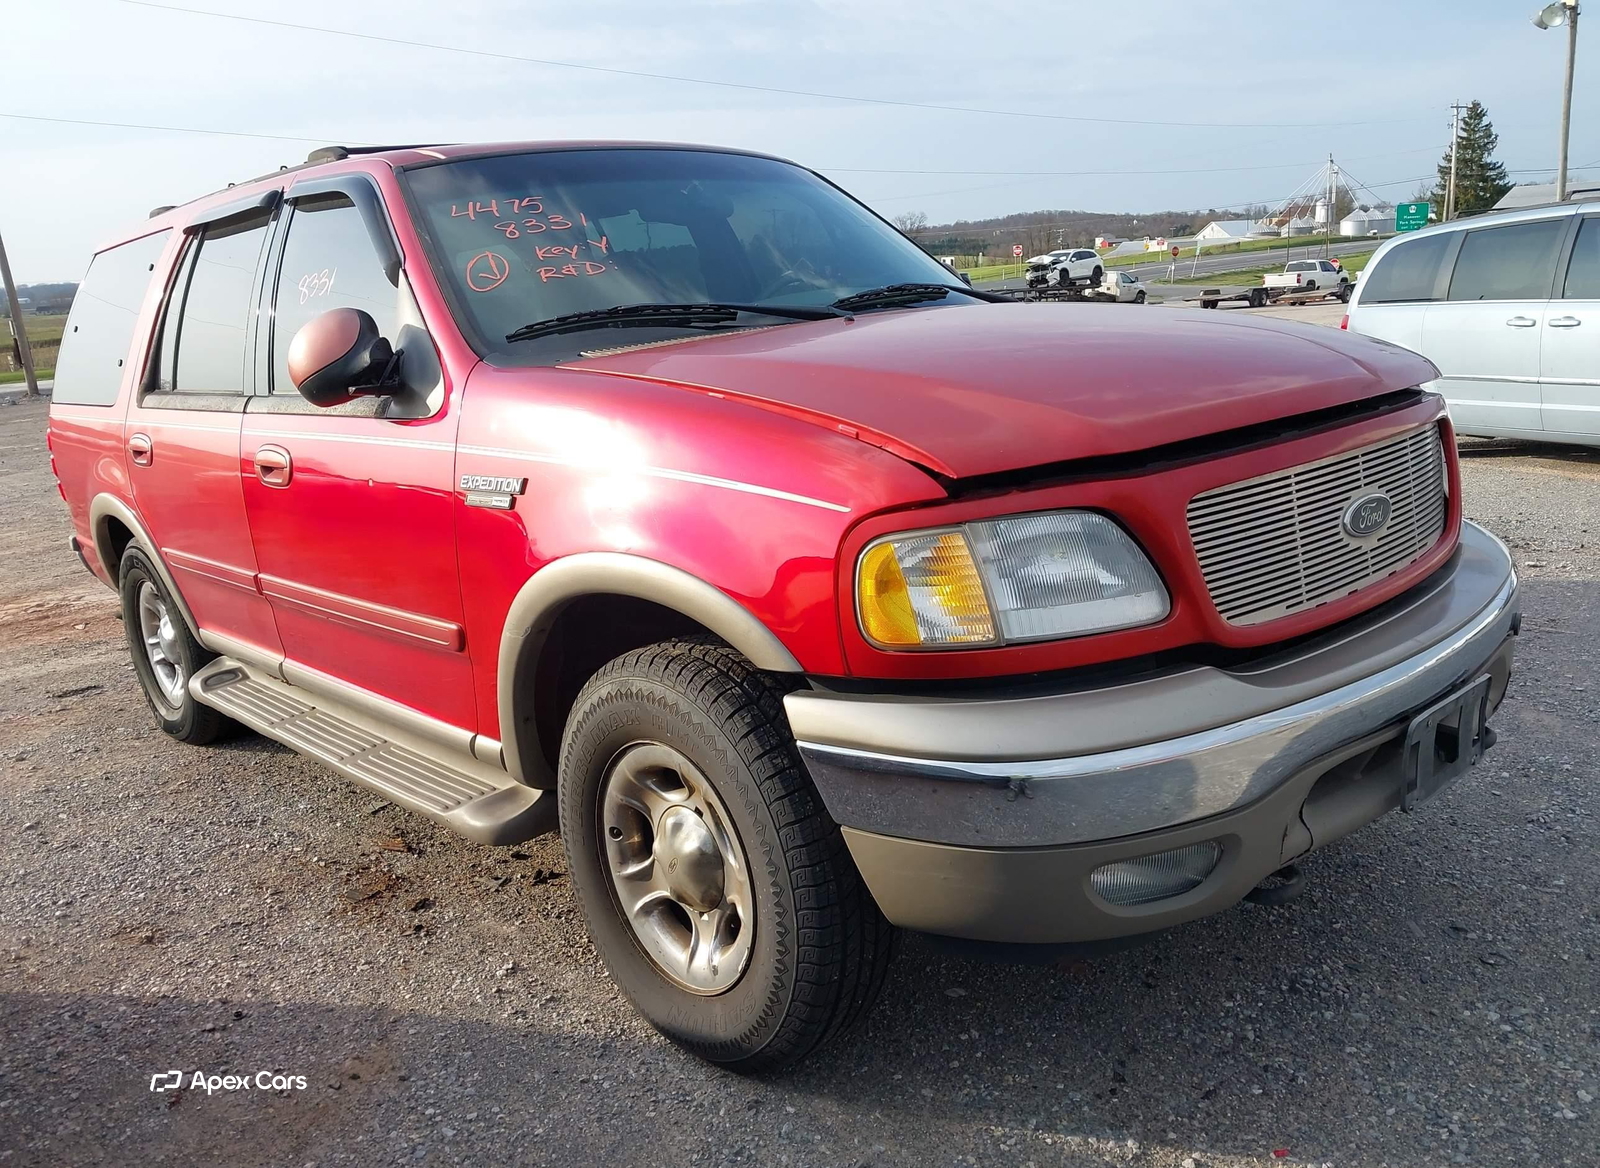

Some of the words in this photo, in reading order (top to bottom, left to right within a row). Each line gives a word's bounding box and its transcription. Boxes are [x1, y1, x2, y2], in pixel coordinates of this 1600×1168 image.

[451, 196, 543, 221] 4475
[494, 212, 587, 239] 8331
[298, 266, 338, 305] 8331
[460, 475, 522, 492] EXPEDITION
[1359, 501, 1384, 529] Ford
